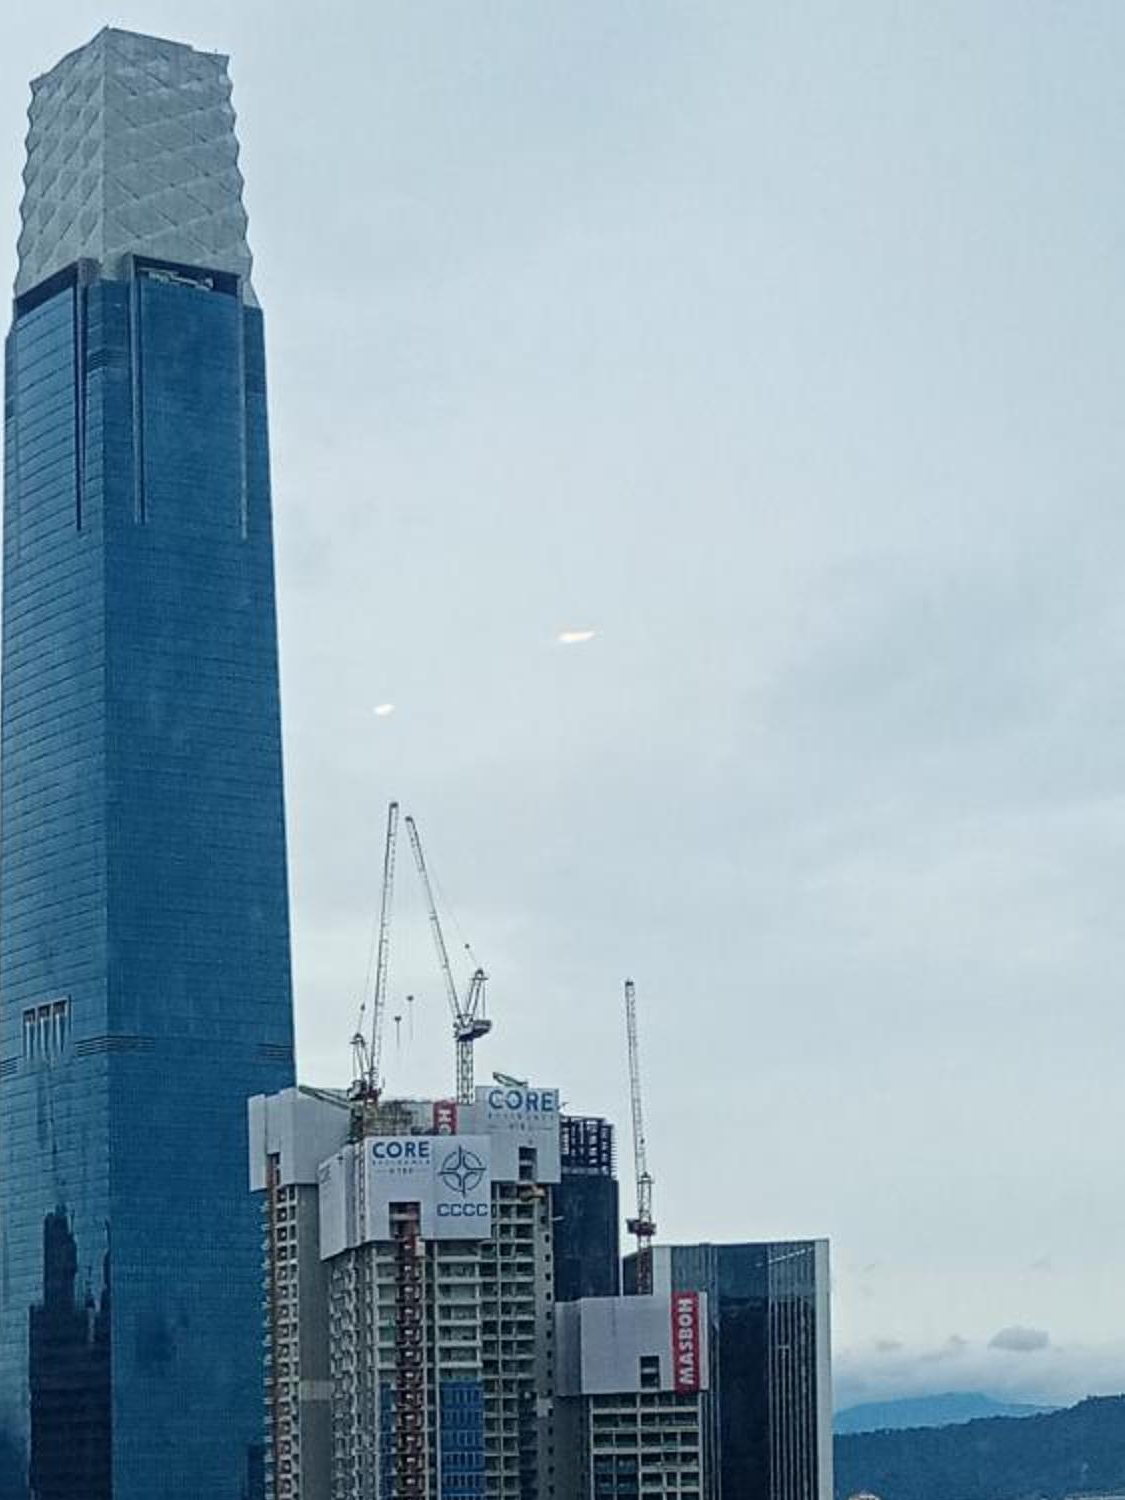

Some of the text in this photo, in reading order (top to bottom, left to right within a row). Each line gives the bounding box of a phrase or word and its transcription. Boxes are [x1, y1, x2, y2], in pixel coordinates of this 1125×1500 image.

[488, 1089, 553, 1112] CORE
[372, 1141, 430, 1159] CORE
[437, 1203, 489, 1217] CCCC
[678, 1297, 694, 1385] MASBOH
